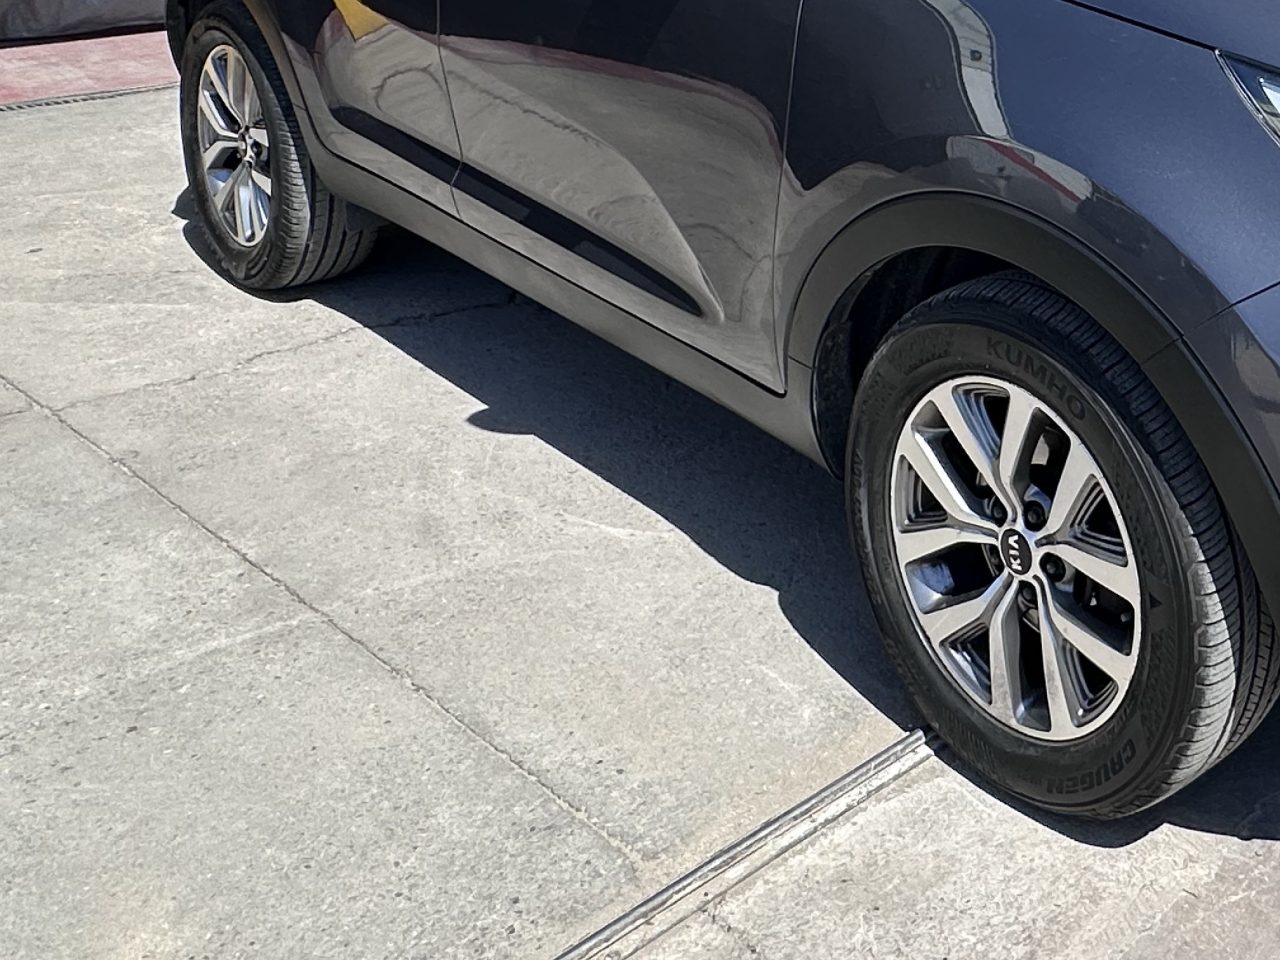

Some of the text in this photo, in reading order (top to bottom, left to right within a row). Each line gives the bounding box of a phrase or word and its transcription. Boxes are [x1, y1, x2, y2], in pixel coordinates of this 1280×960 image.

[986, 336, 1087, 421] KUMHO
[1008, 534, 1023, 571] KIA
[1046, 739, 1136, 795] CRUGEN
